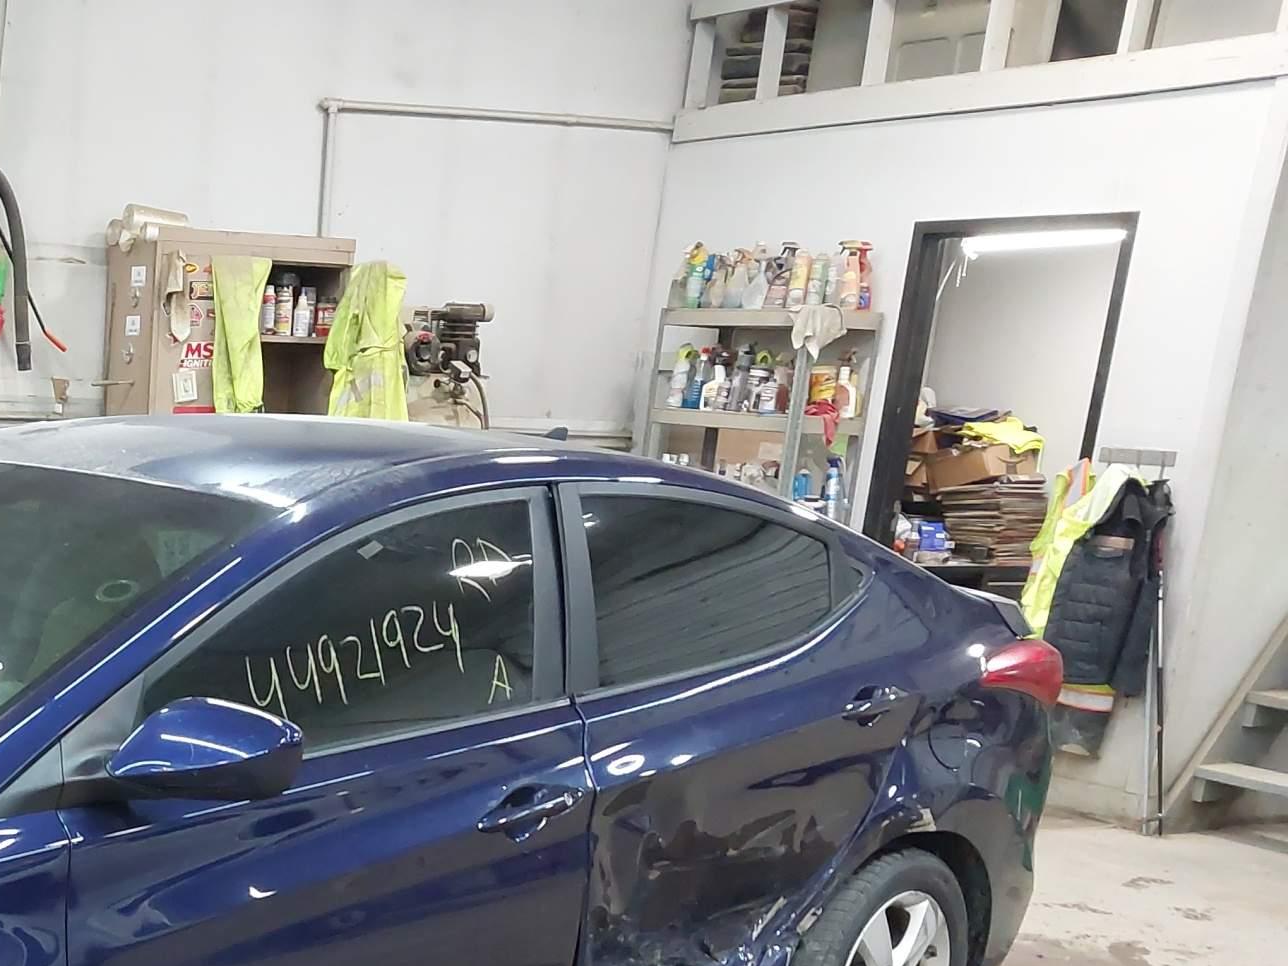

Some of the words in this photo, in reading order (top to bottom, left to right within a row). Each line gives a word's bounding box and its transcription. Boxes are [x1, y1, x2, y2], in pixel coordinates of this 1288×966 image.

[185, 343, 214, 359] MS
[245, 600, 465, 721] 44921924
[487, 653, 513, 705] A
